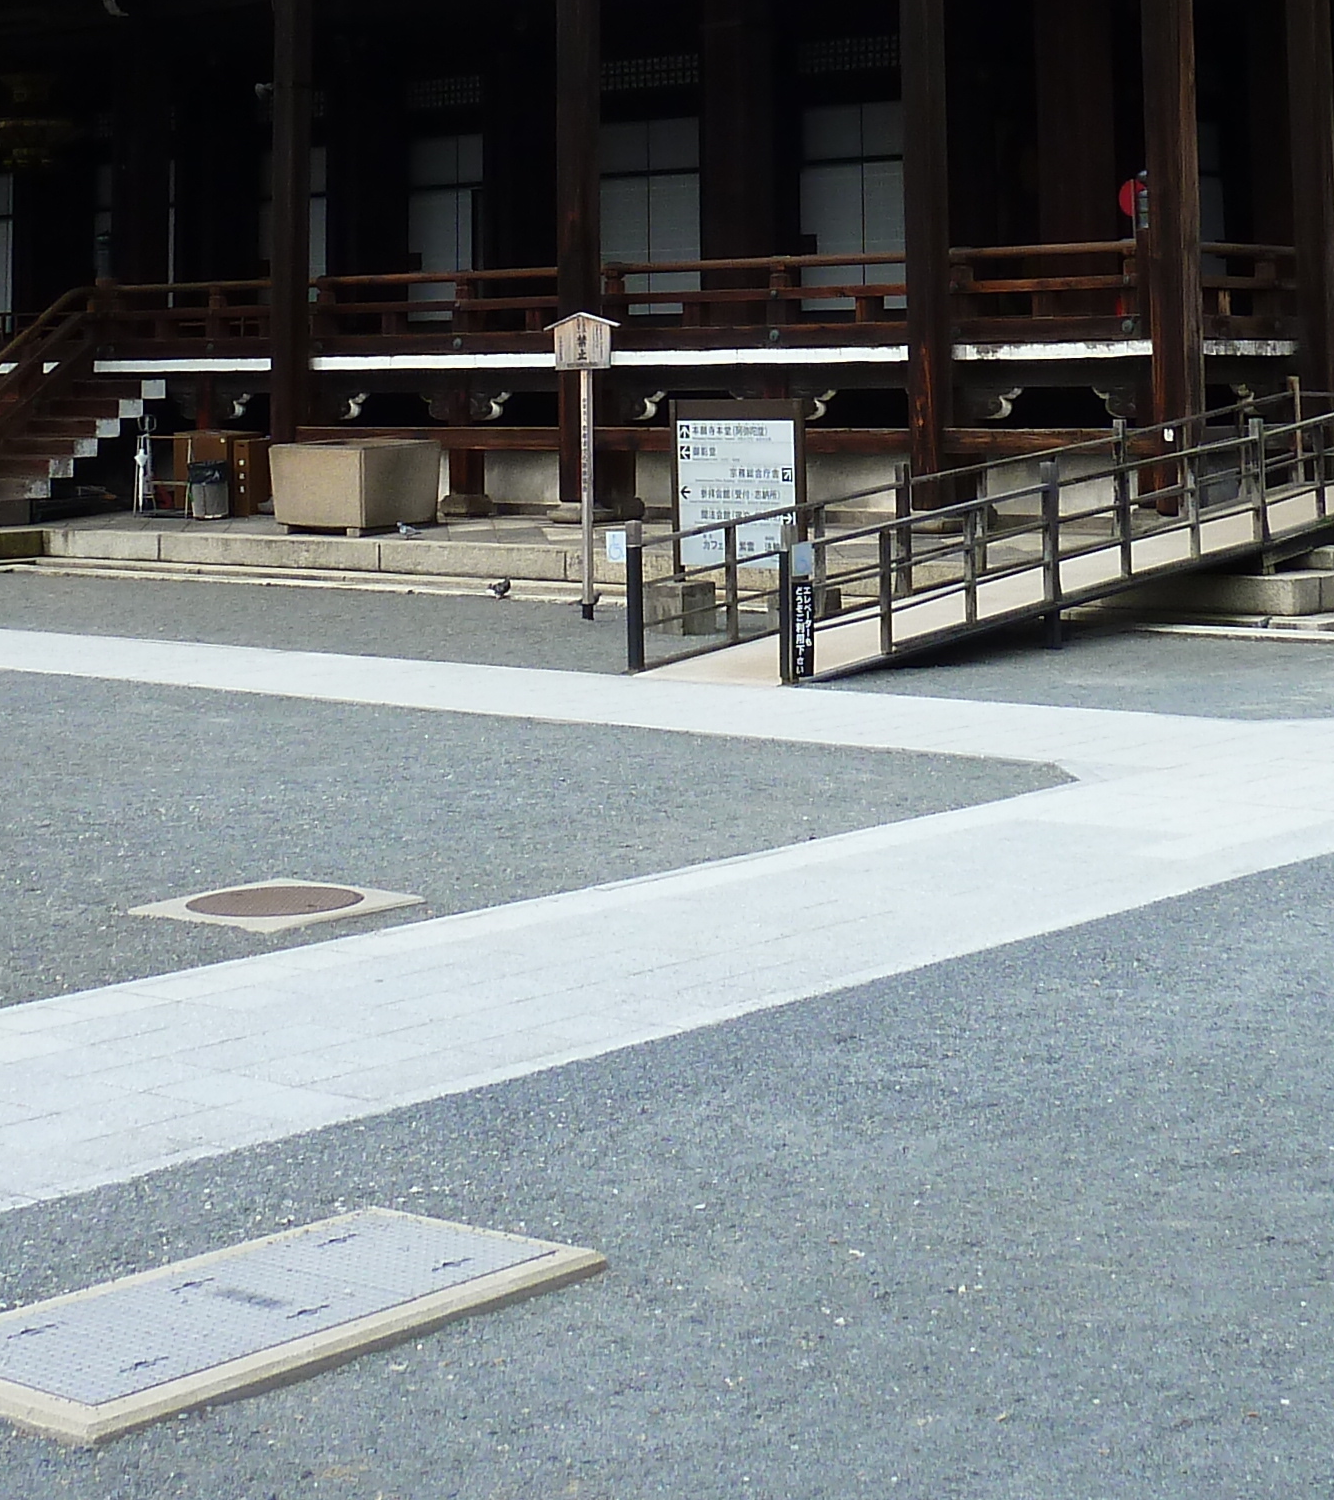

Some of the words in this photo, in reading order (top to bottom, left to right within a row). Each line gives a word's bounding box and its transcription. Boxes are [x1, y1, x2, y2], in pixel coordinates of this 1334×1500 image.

[803, 587, 813, 647] エレベーターも
